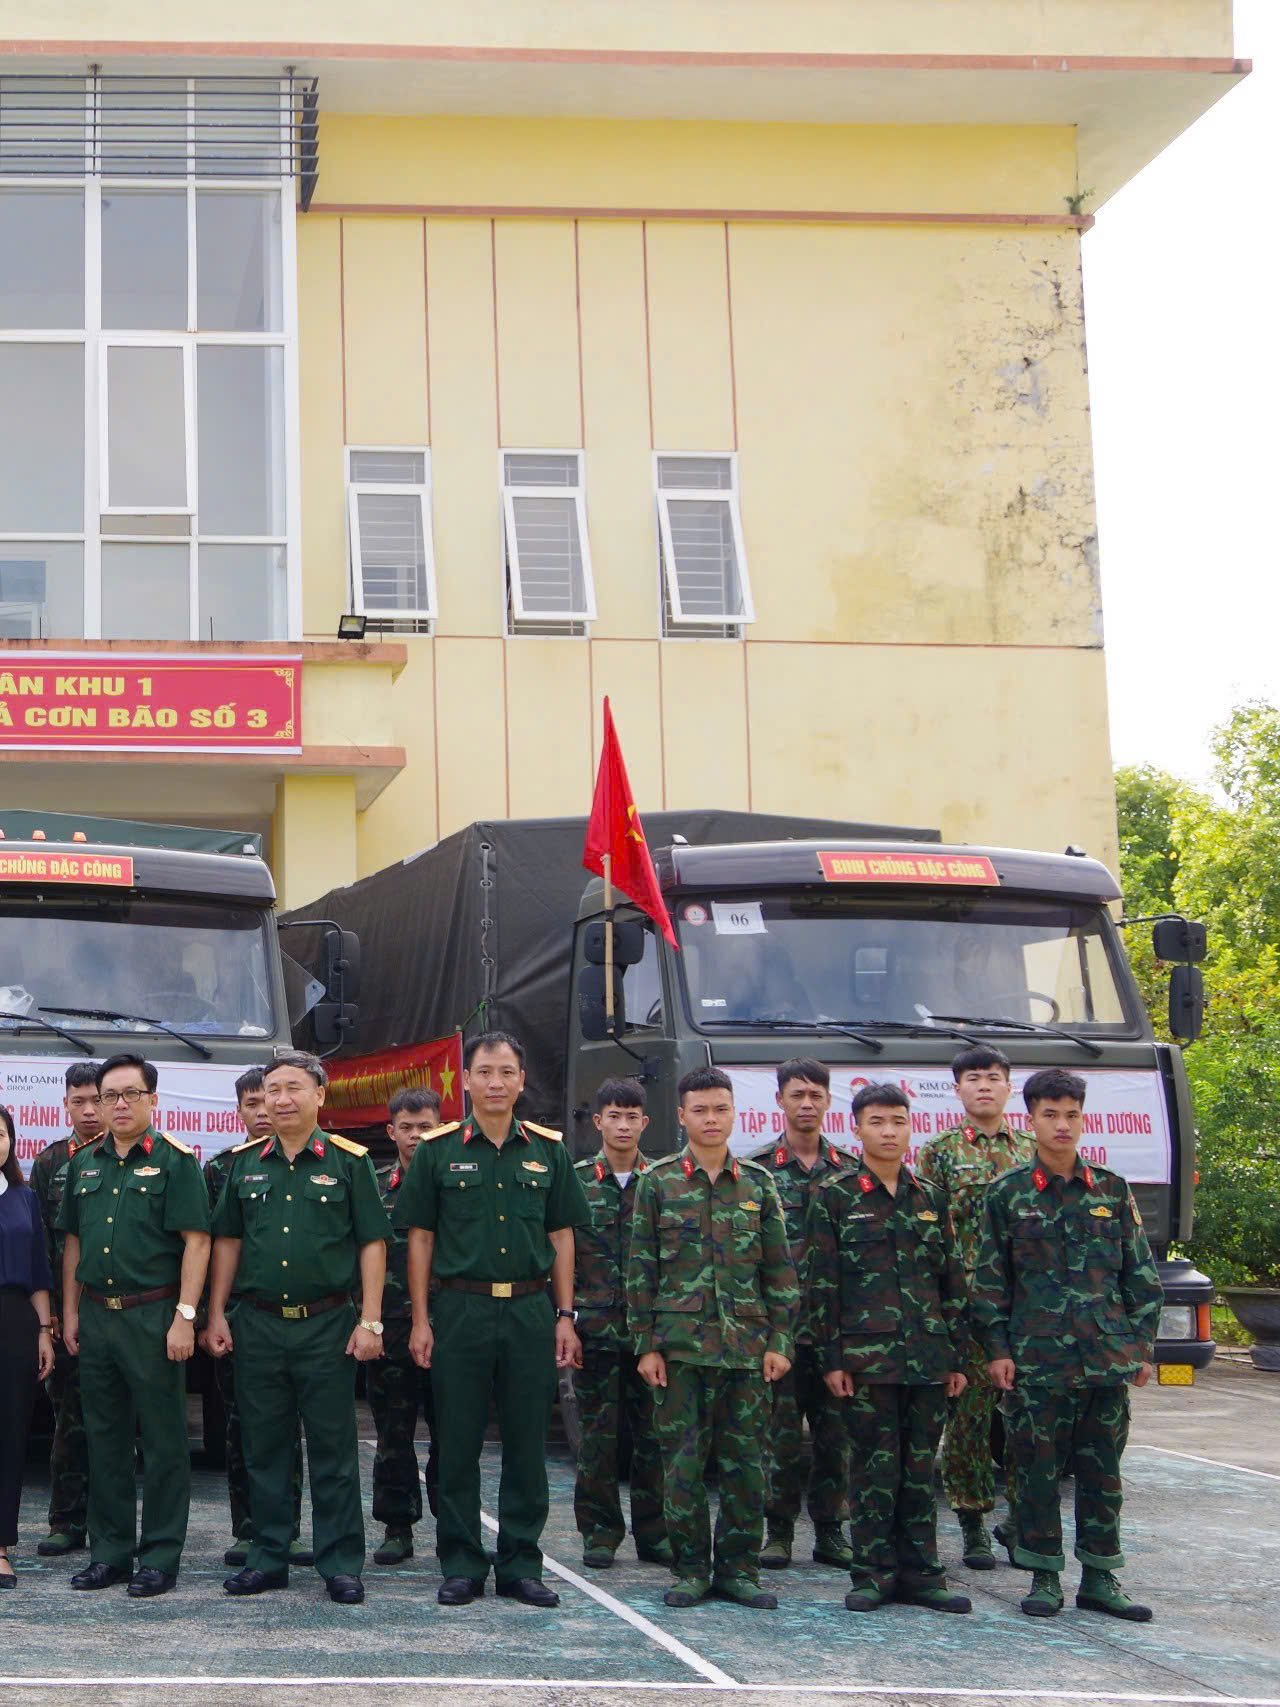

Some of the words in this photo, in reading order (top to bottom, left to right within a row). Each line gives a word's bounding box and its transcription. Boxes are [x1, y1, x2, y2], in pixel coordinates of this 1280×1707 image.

[55, 676, 125, 696] KHU
[137, 677, 152, 696] 1
[24, 705, 97, 727] CƠN
[108, 705, 178, 727] BÃO
[189, 702, 237, 728] SỐ
[247, 708, 268, 728] 3
[83, 860, 122, 878] CÔNG
[831, 859, 868, 875] BINH
[948, 860, 987, 878] CÔNG
[730, 913, 750, 926] 06
[7, 1075, 28, 1084] KIM
[30, 1075, 64, 1085] OANH
[919, 1082, 939, 1091] KIM
[19, 1100, 61, 1128] HÀNH
[166, 1105, 202, 1132] BÌNH
[206, 1110, 246, 1133] DƯƠN
[739, 1108, 767, 1138] TẬP
[1107, 1111, 1153, 1135] DƯƠNG
